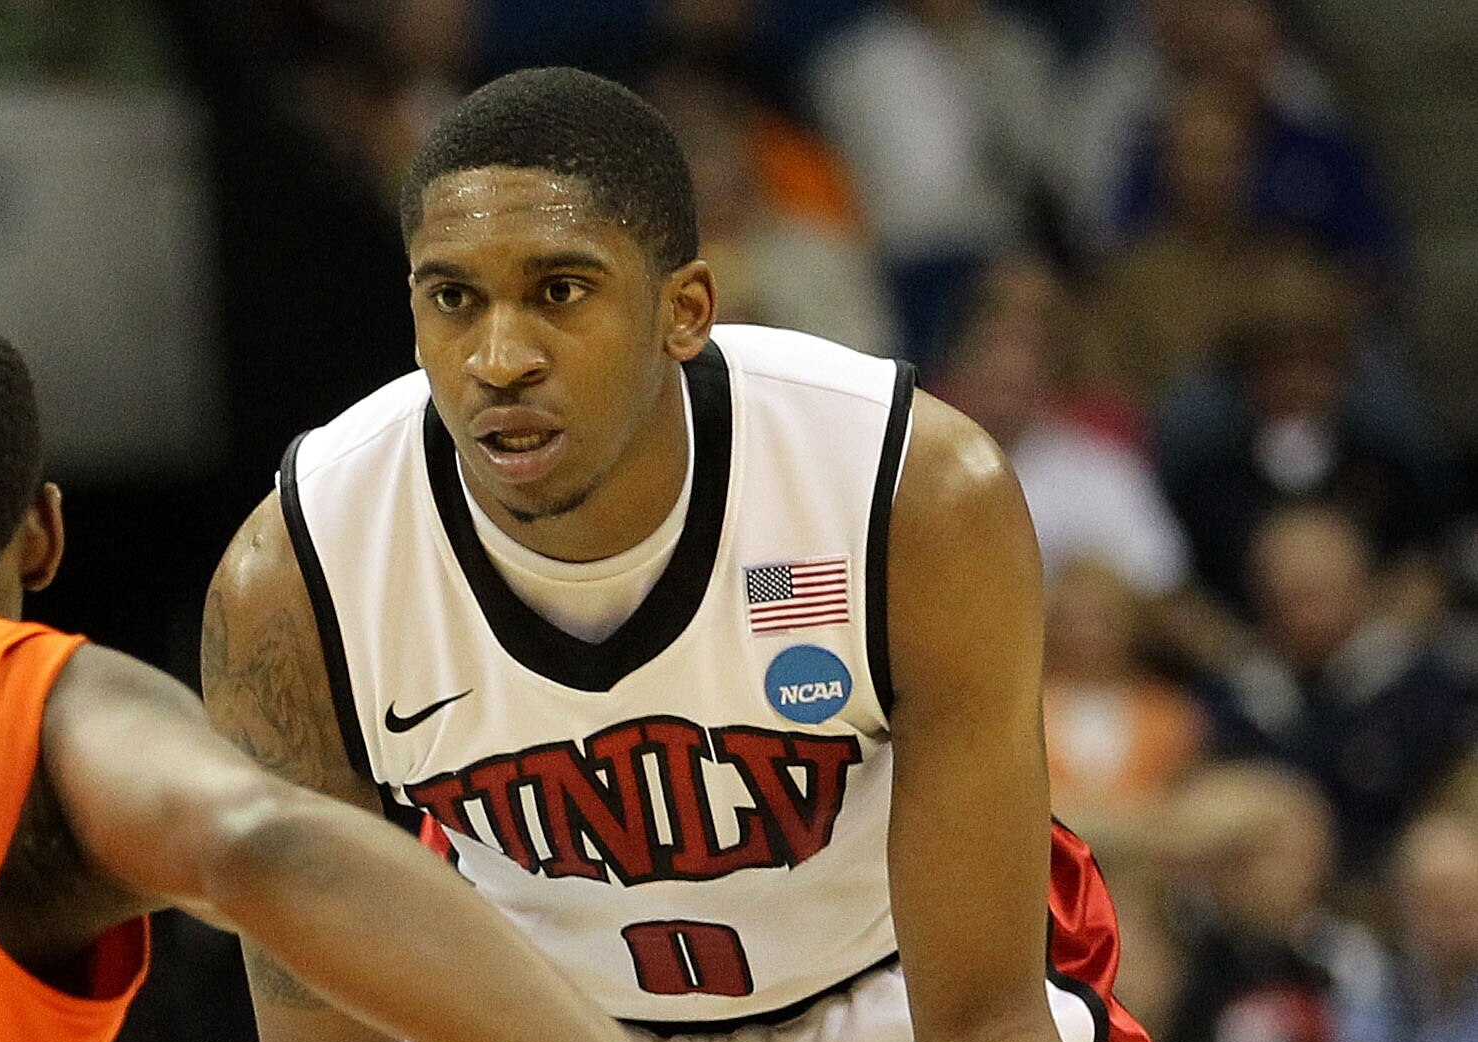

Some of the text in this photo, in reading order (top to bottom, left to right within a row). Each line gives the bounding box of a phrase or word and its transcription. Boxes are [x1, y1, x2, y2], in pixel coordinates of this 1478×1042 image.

[779, 680, 844, 706] NCAA
[401, 714, 863, 888] UNLV
[621, 919, 754, 998] 0
